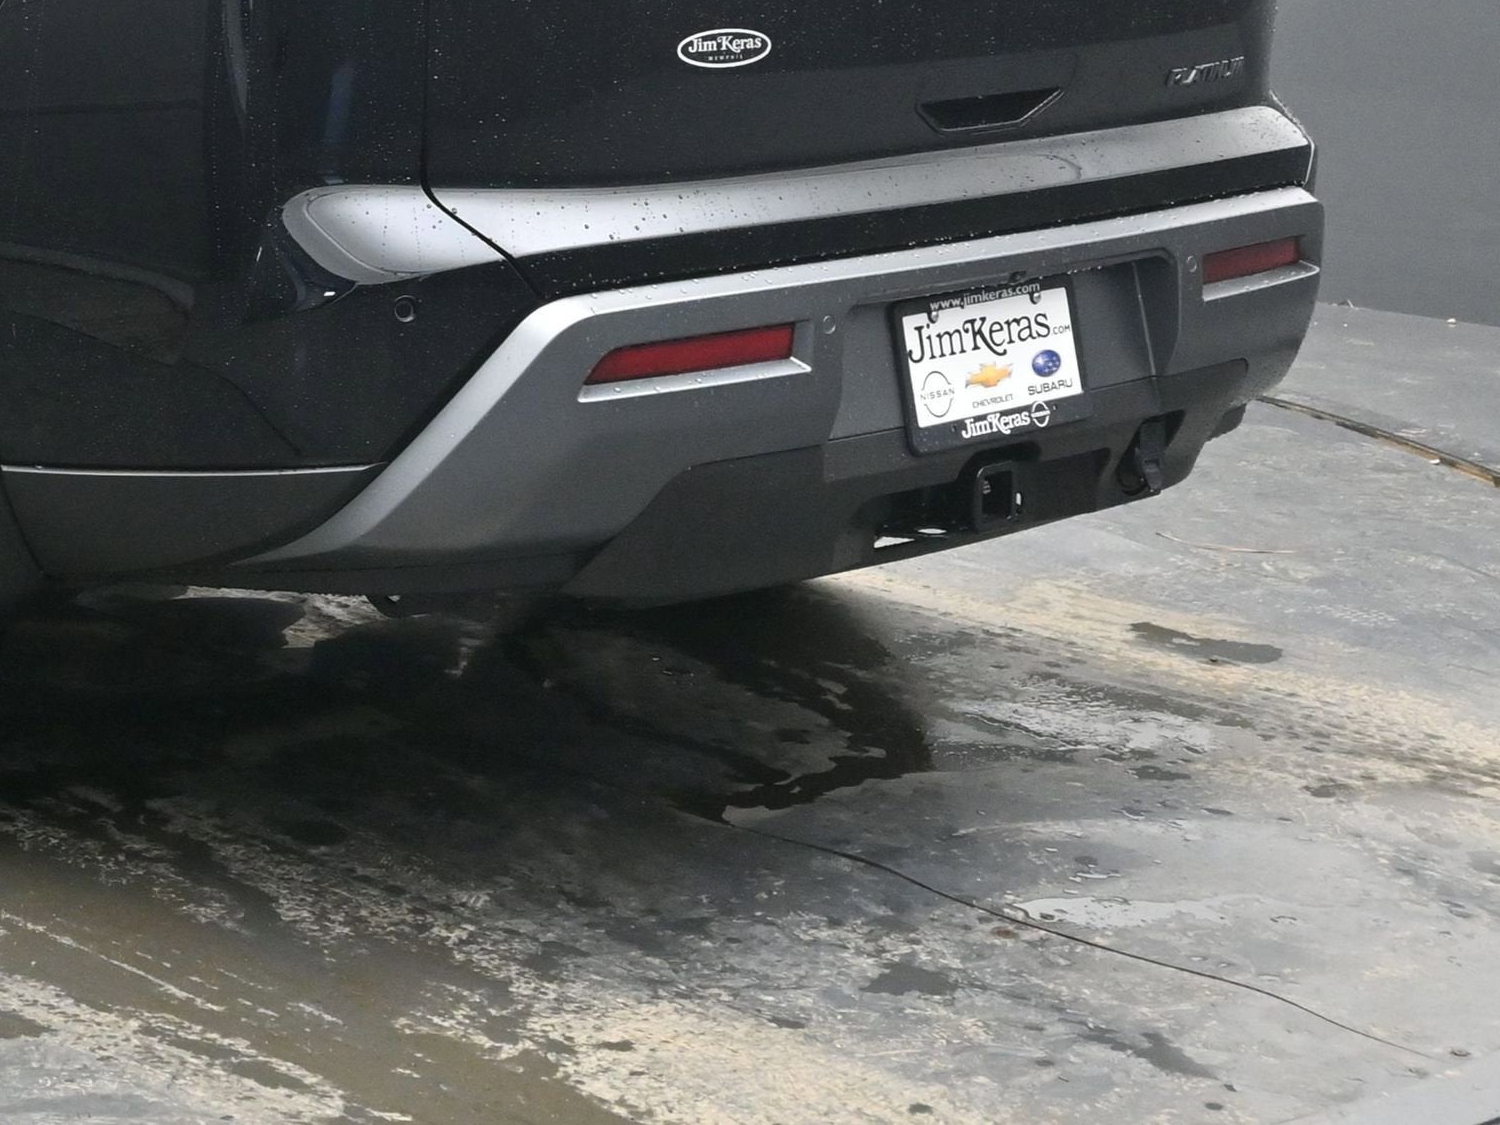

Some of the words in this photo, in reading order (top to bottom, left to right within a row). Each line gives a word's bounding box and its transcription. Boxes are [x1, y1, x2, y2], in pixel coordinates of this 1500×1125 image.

[929, 283, 1041, 311] www.jimkeras.com
[920, 387, 955, 400] NISSAN
[1028, 378, 1073, 396] SUBARU
[972, 393, 1013, 409] CHEVROLET
